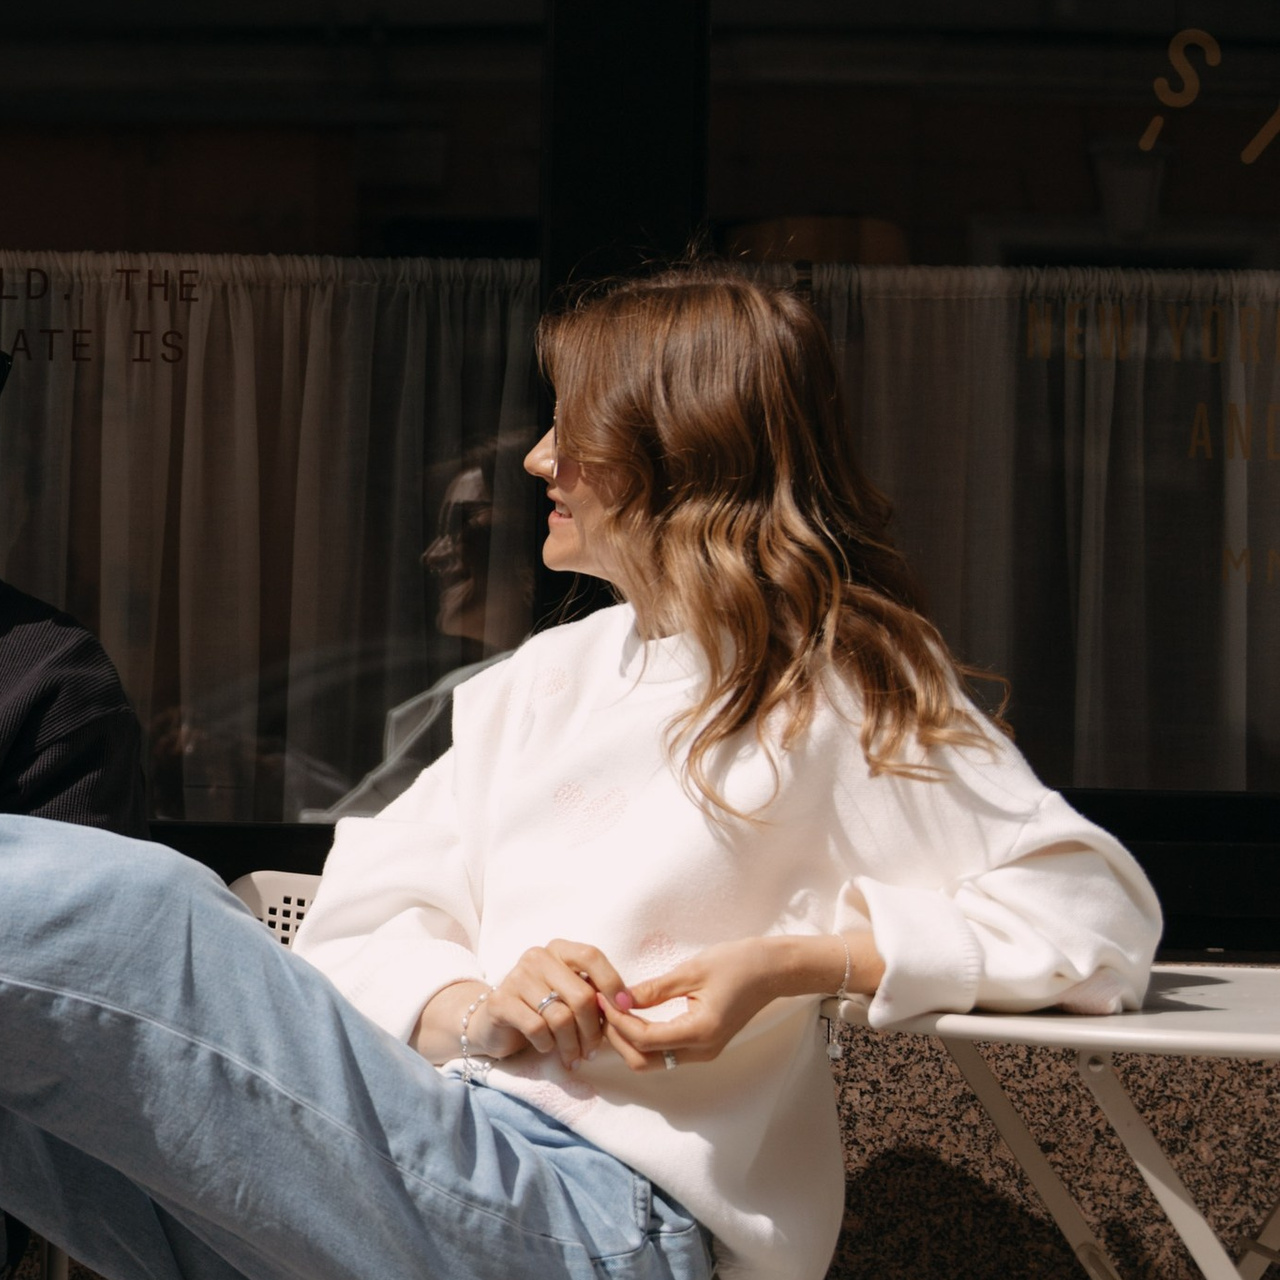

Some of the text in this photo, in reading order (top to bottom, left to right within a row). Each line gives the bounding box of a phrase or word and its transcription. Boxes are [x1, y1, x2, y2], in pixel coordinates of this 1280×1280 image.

[115, 269, 200, 302] THE
[131, 330, 184, 364] IS
[1025, 301, 1280, 364] NEW YOR
